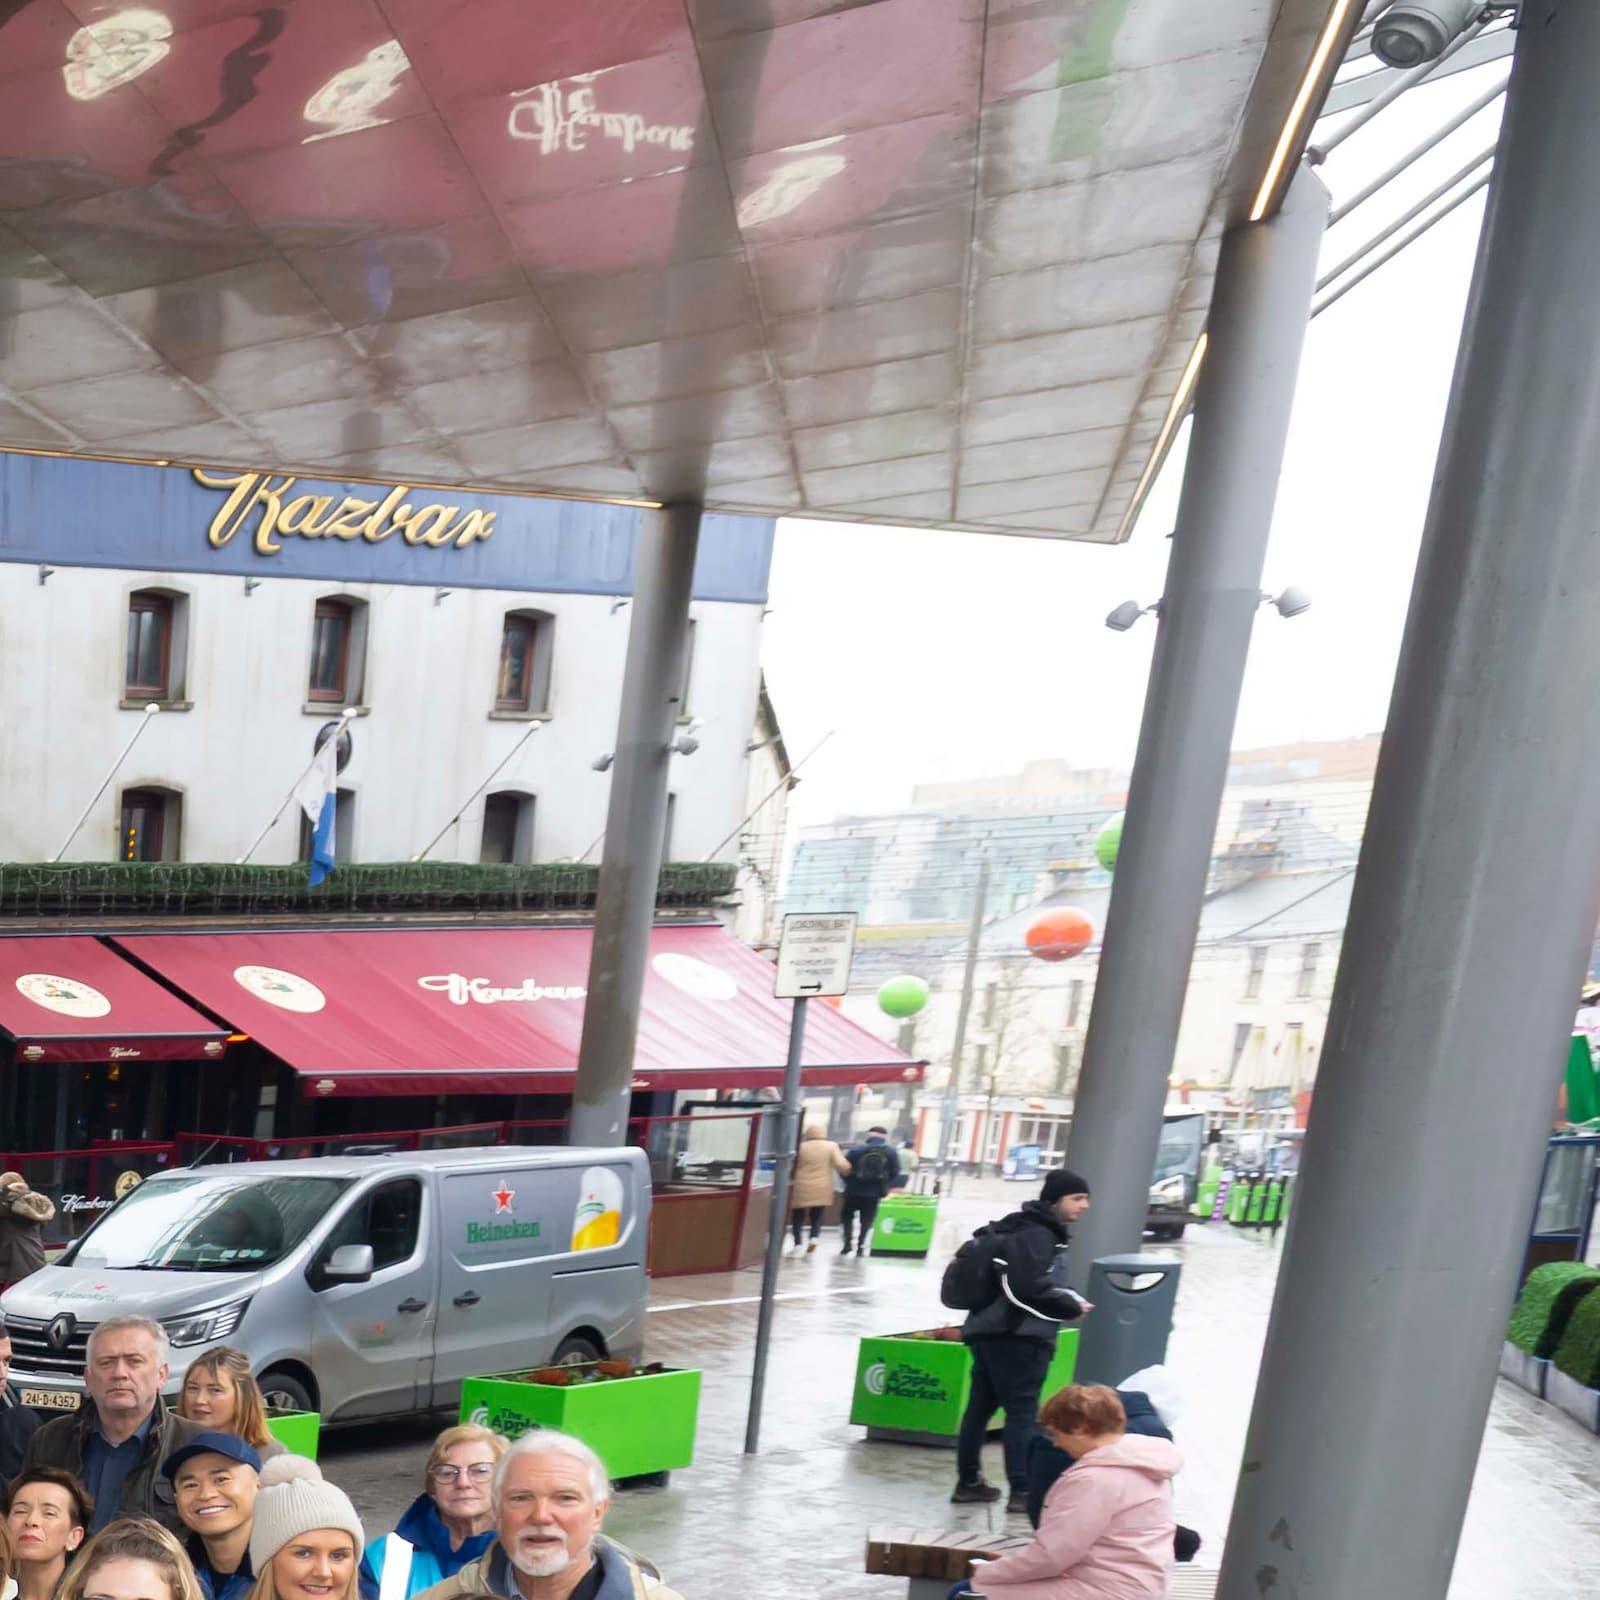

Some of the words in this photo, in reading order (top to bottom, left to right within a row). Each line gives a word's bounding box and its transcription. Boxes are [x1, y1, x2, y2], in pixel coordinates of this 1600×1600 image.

[193, 469, 497, 554] Kazbar
[466, 1218, 541, 1245] Heineken
[25, 1392, 76, 1409] 241-D-4352
